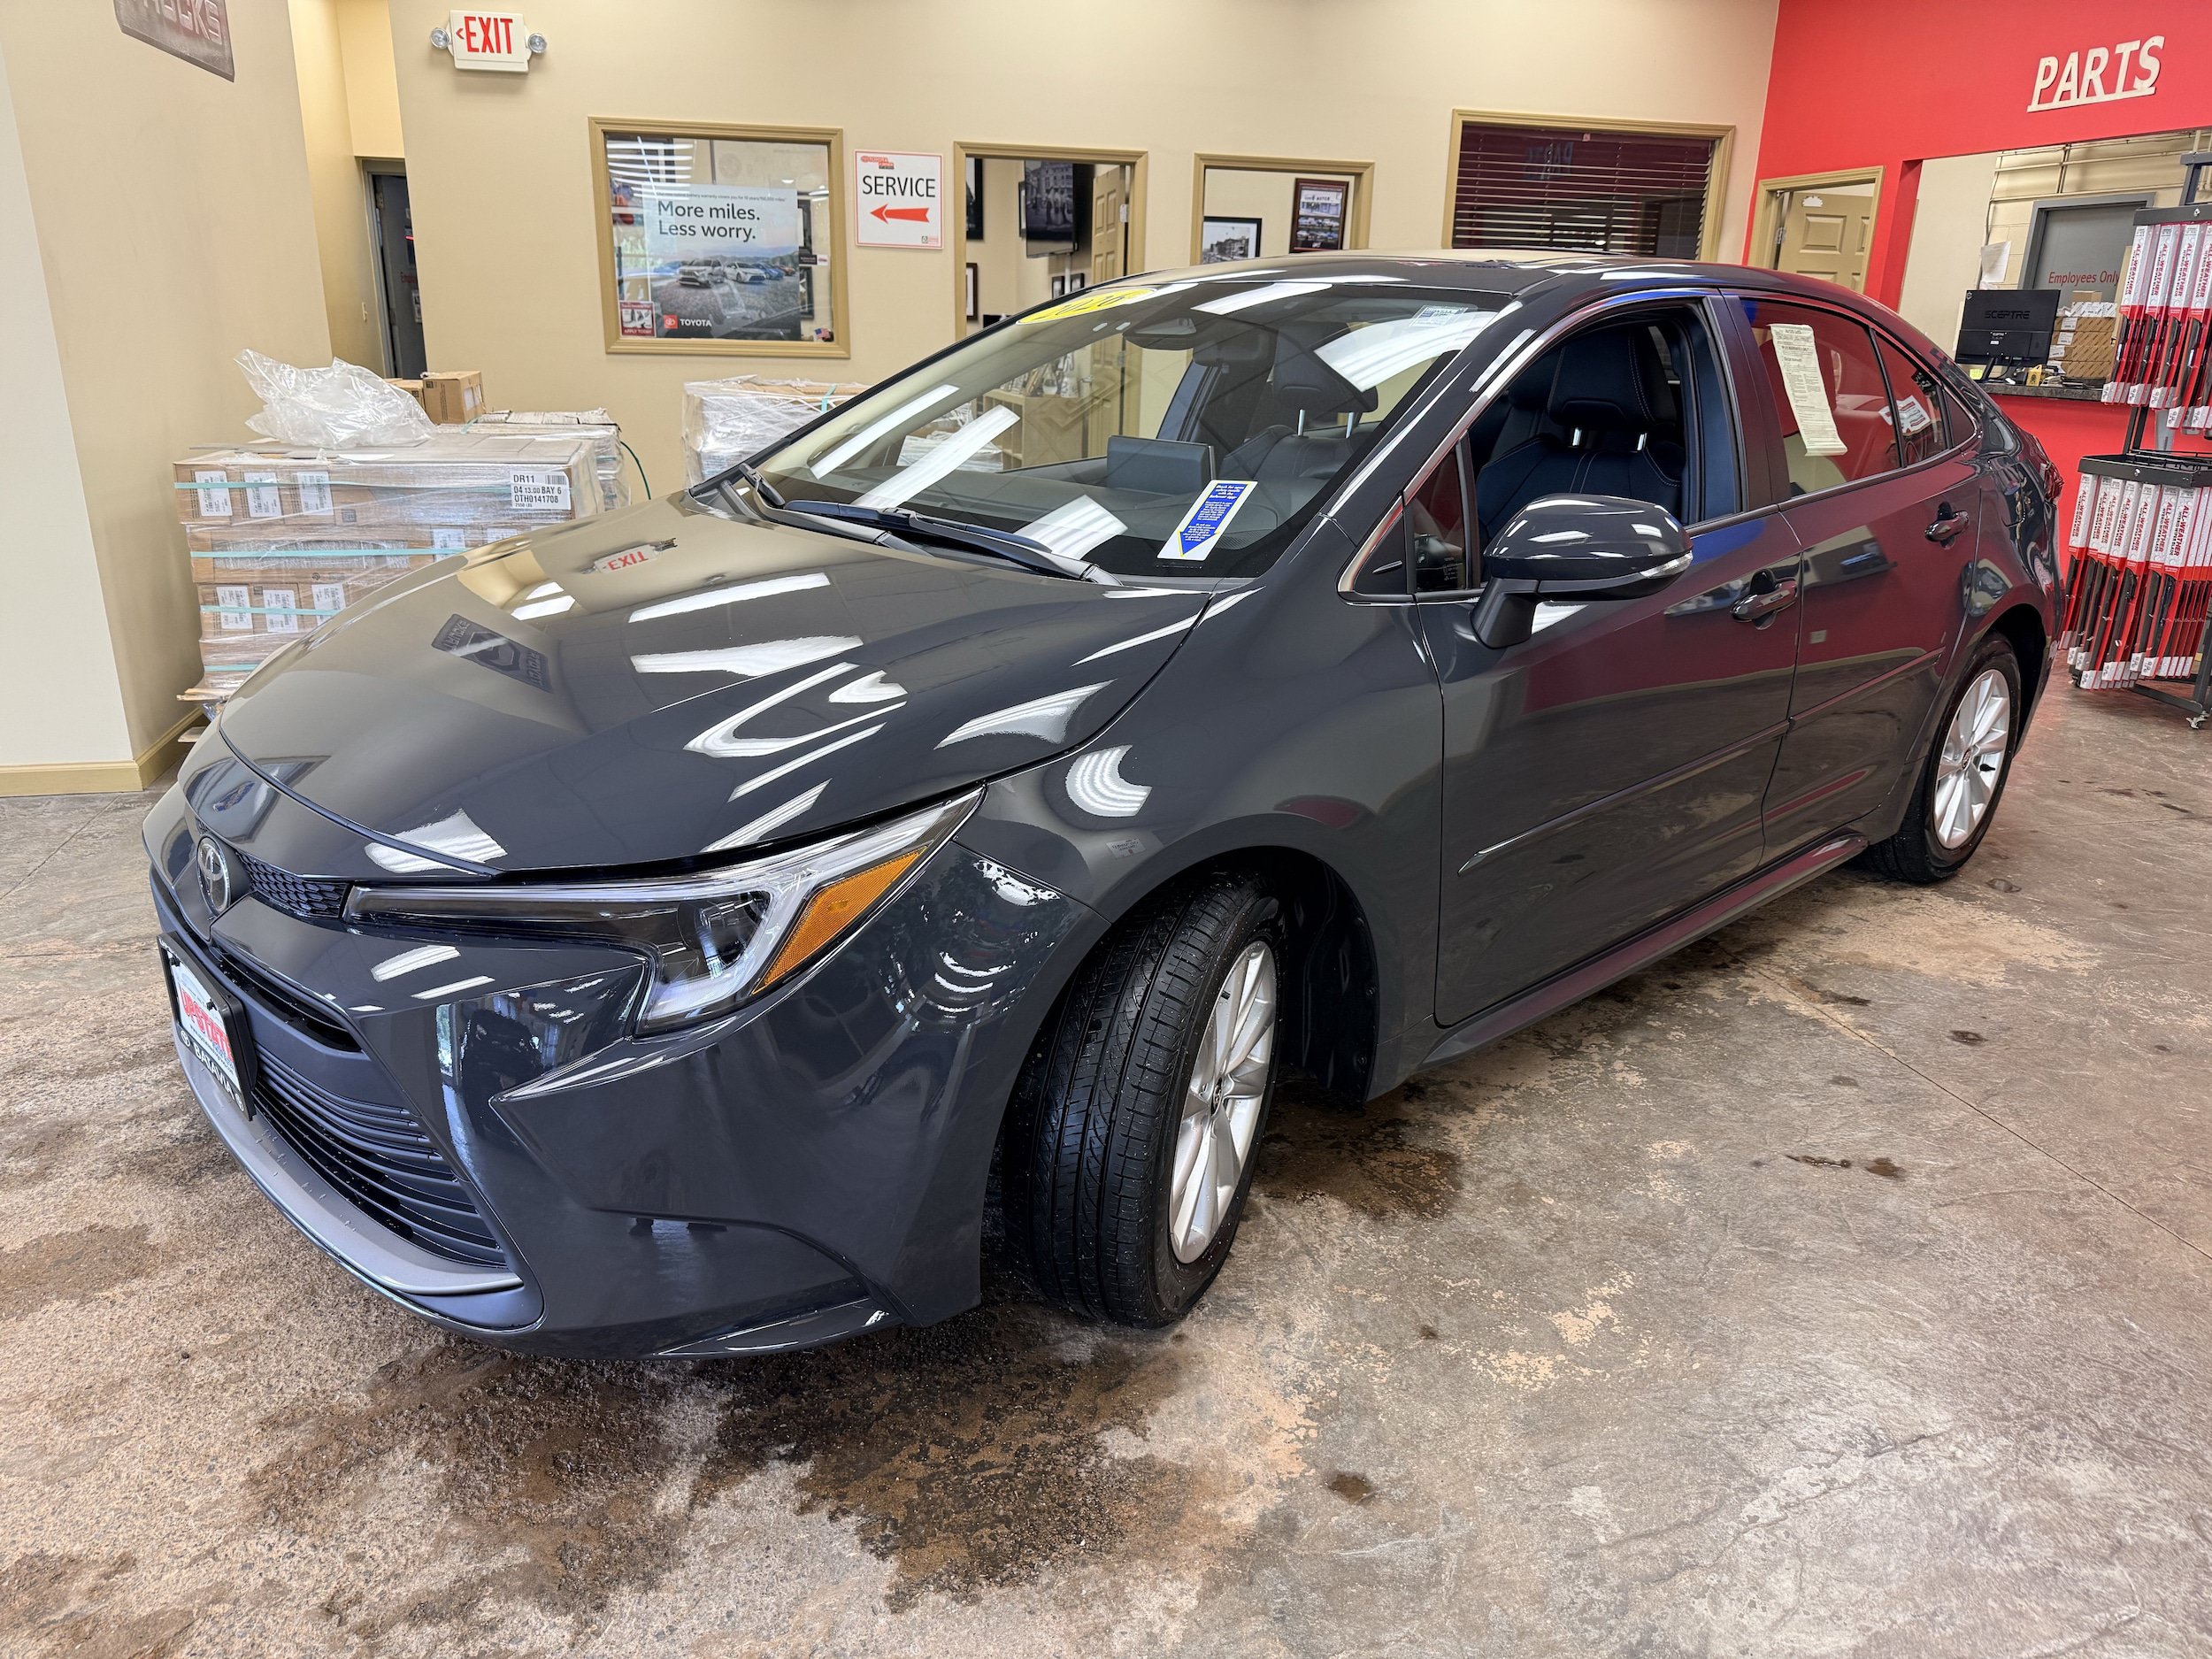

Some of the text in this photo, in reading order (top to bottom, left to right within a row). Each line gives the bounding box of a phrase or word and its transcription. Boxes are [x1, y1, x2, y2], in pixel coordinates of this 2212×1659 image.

[464, 16, 513, 54] EXIT
[2029, 35, 2165, 108] PARTS
[657, 200, 760, 221] More miles.
[863, 175, 936, 198] SERVICE
[658, 219, 757, 242] Less worry.
[2048, 270, 2120, 287] Employees Only
[2128, 243, 2141, 295] ALL-WEATHER
[2154, 243, 2168, 296] ALL-WEATHER
[2178, 243, 2193, 296] ALL-WEATHER
[680, 318, 712, 327] TOYOTA
[1985, 310, 2031, 319] SCEPTRE
[513, 474, 534, 483] DR11
[2073, 490, 2087, 537] ALL-WEATHER
[2093, 492, 2108, 540] ALL-WEATHER
[2103, 495, 2116, 544] ALL-WEATHER
[2117, 498, 2131, 547] ALL-WEATHER
[2134, 502, 2148, 551] ALL-WEATHER
[2159, 503, 2173, 553] ALL-WEATHER
[2174, 505, 2190, 557] ALL-WEATHER
[180, 987, 234, 1063] UPSTATE
[194, 1042, 235, 1101] BATAVIA
